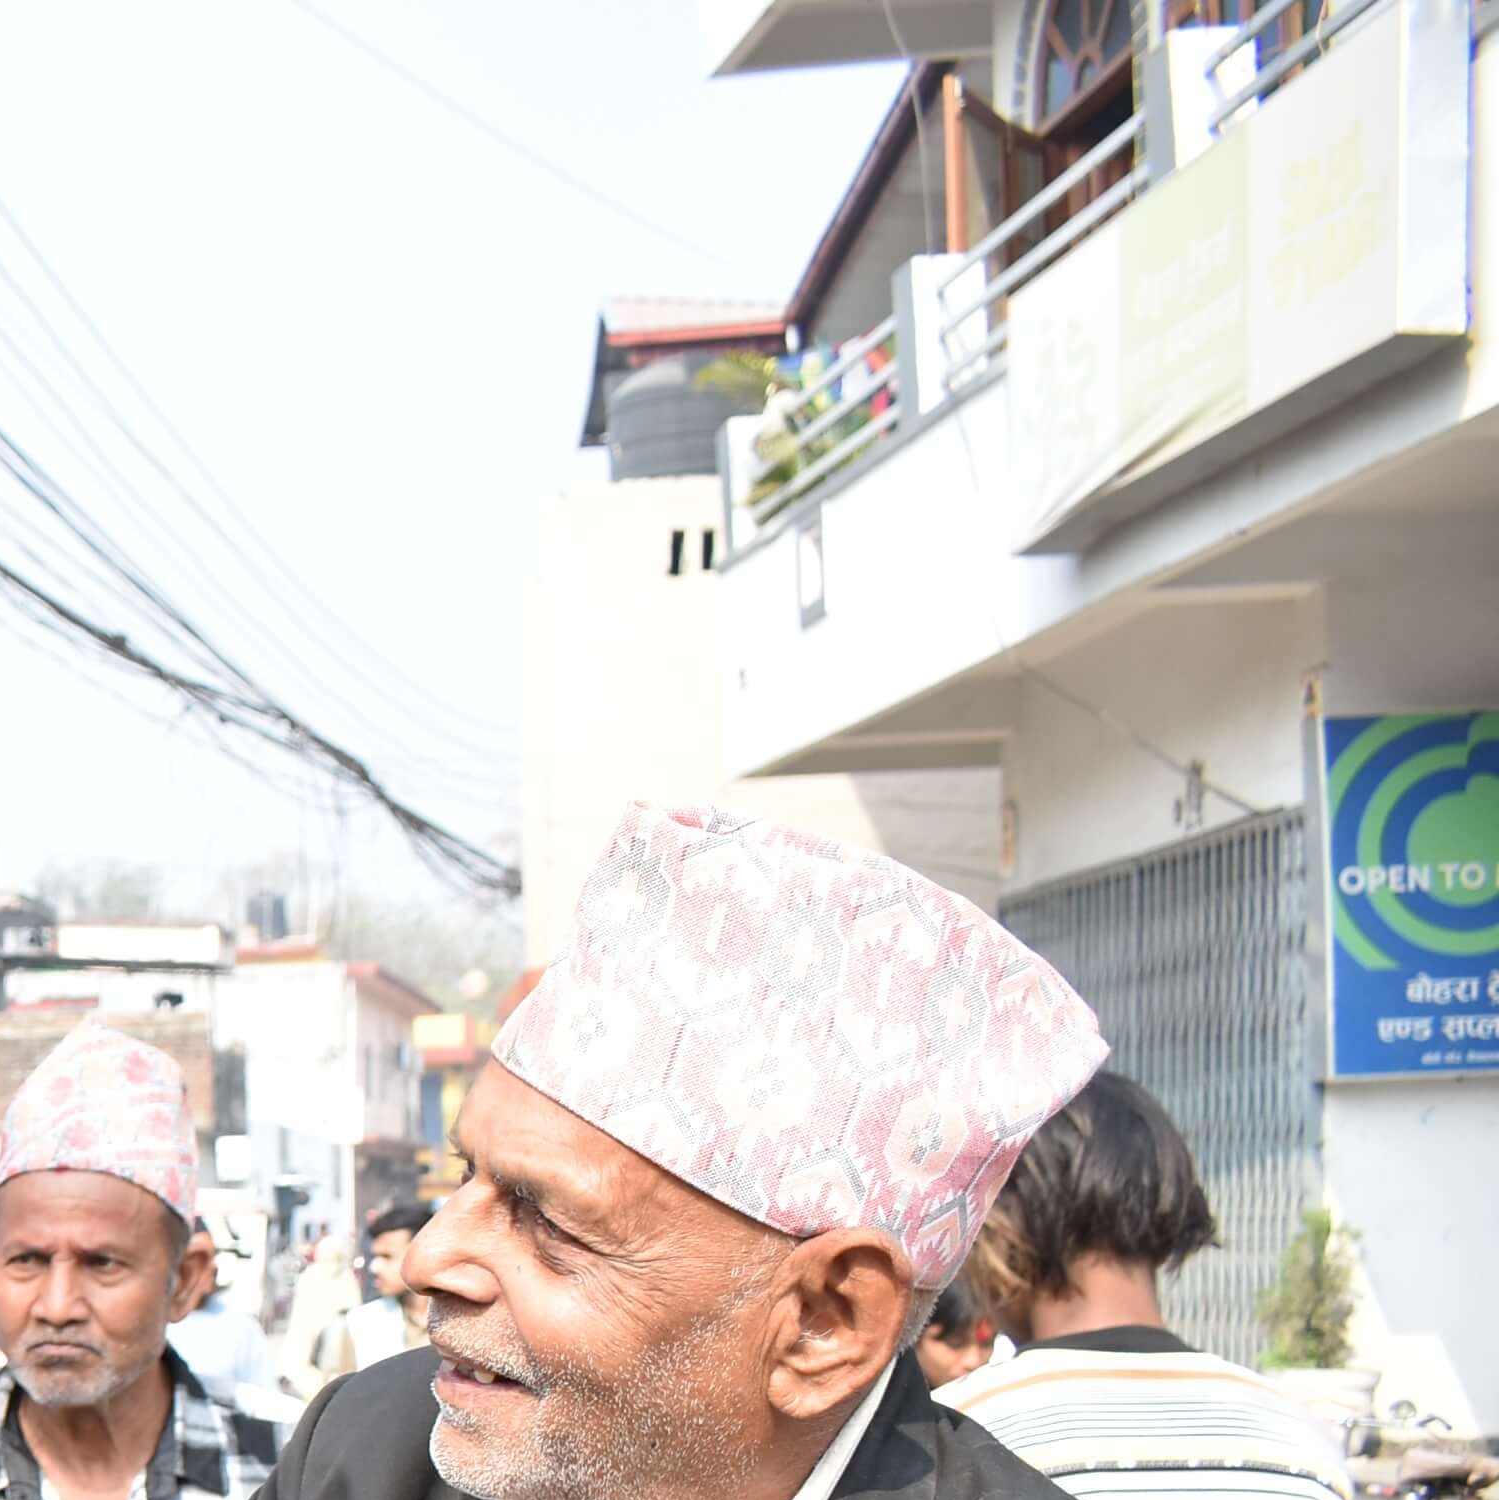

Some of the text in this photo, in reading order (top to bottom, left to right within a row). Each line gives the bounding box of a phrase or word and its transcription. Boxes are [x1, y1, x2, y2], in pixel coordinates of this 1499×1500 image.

[1339, 864, 1429, 896] OPEN
[1437, 862, 1485, 890] TO
[1406, 971, 1480, 1005] बोहरा
